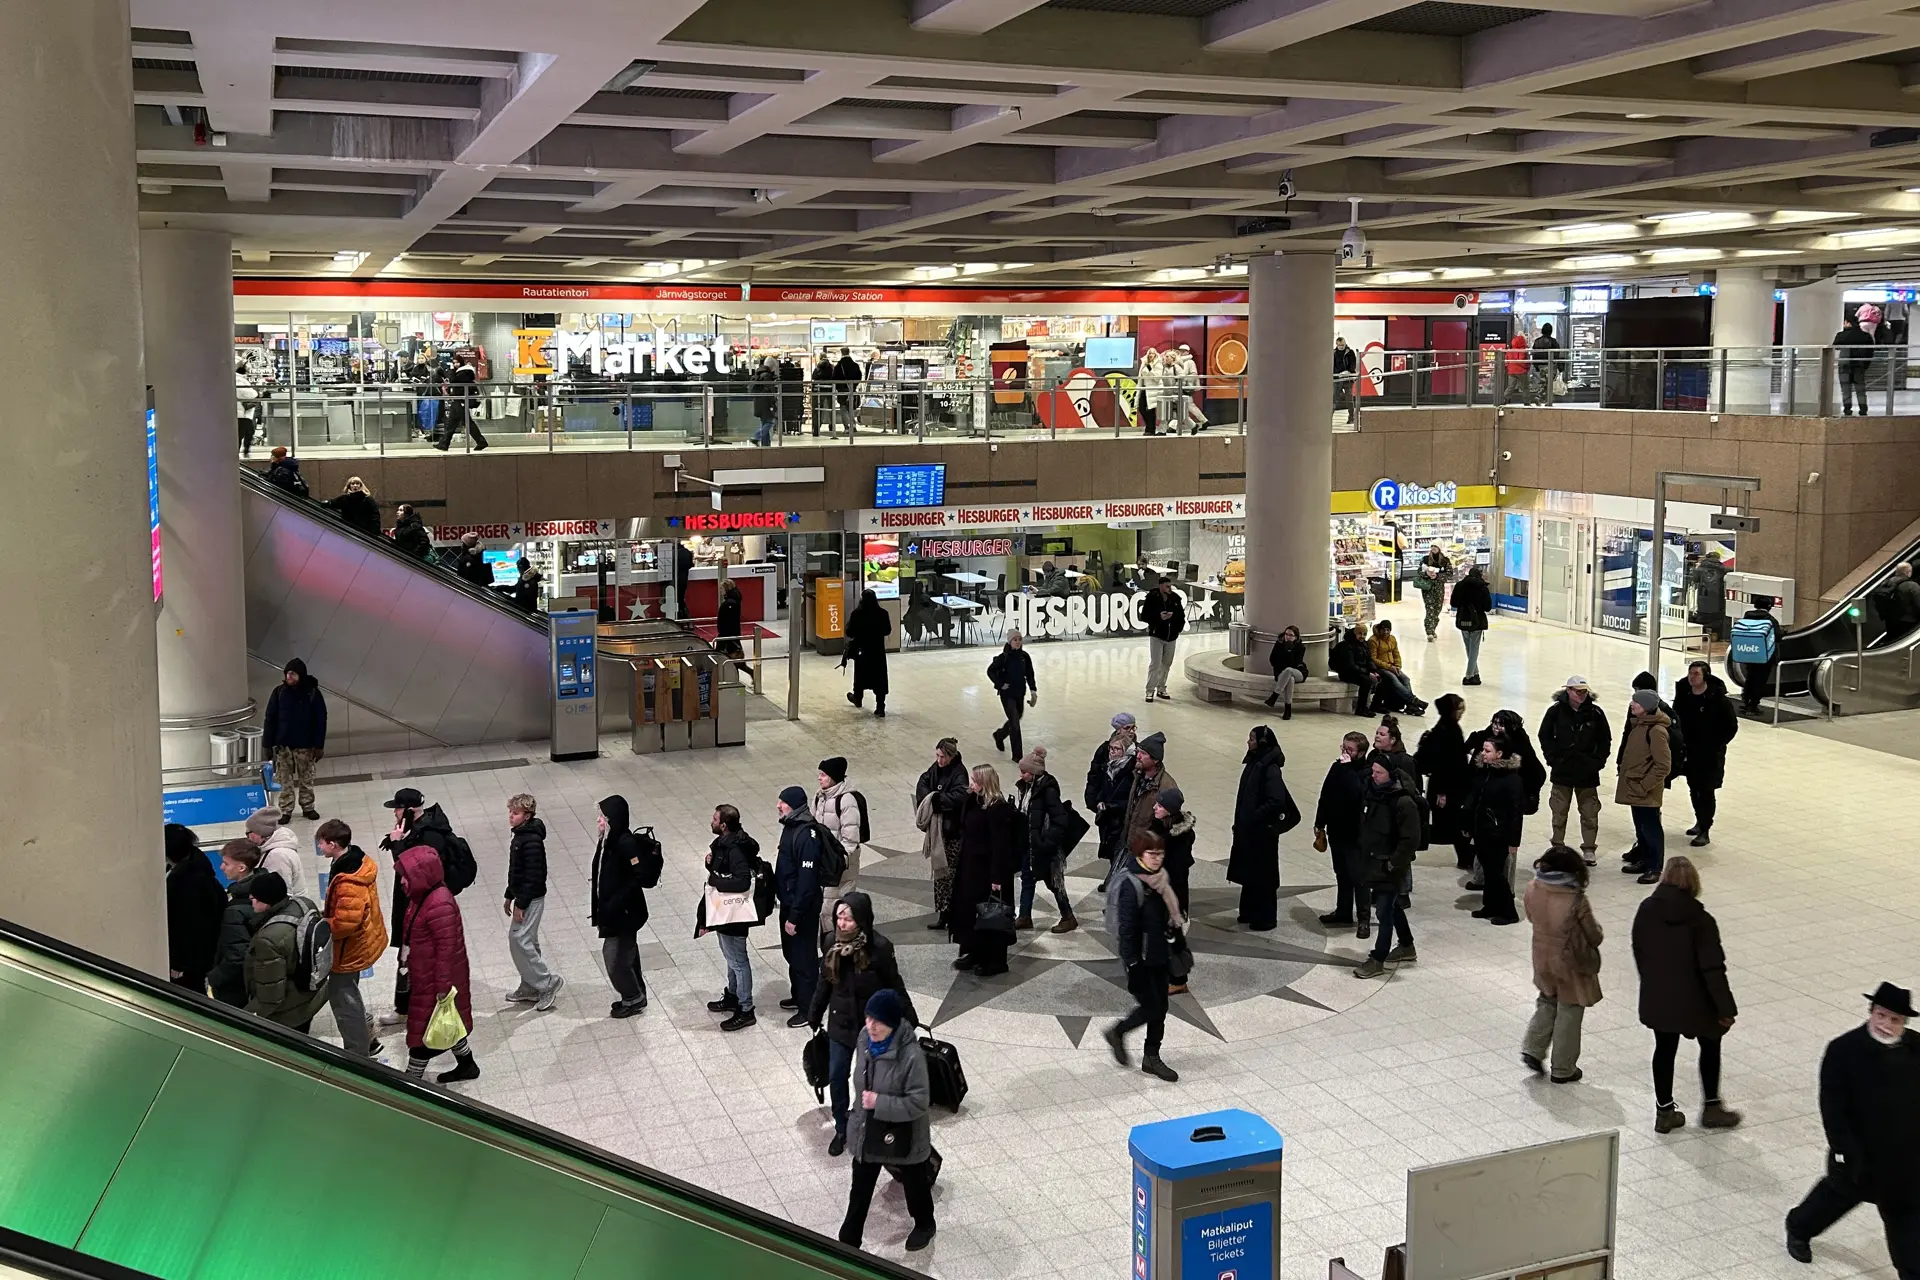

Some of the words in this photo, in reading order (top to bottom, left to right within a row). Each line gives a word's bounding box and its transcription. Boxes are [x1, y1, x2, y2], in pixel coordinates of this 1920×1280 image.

[522, 287, 589, 297] Rautatientori
[656, 289, 728, 300] Järnvägstorget
[781, 290, 814, 300] Central
[815, 291, 850, 302] Railway
[851, 292, 883, 301] Station
[556, 327, 731, 374] Market
[1402, 484, 1456, 504] kioski
[958, 508, 1021, 523] HESBURGER
[1032, 505, 1093, 521] HESBURGER
[1105, 502, 1164, 518] HESBURGER
[1176, 500, 1234, 515] HESBURGER
[685, 511, 787, 530] HESBURGER
[881, 511, 946, 527] HESBURGER
[525, 520, 599, 537] HESBURGER
[1606, 524, 1634, 539] NOCCO
[922, 538, 1012, 558] HESBURGER
[828, 604, 841, 631] posti
[1005, 586, 1191, 637] HESBURG
[1602, 614, 1631, 631] NOCCO
[1736, 643, 1760, 653] Wolt
[1201, 1219, 1254, 1239] Matkaliput
[1208, 1234, 1247, 1251] Biljetter
[1210, 1247, 1245, 1263] Tickets
